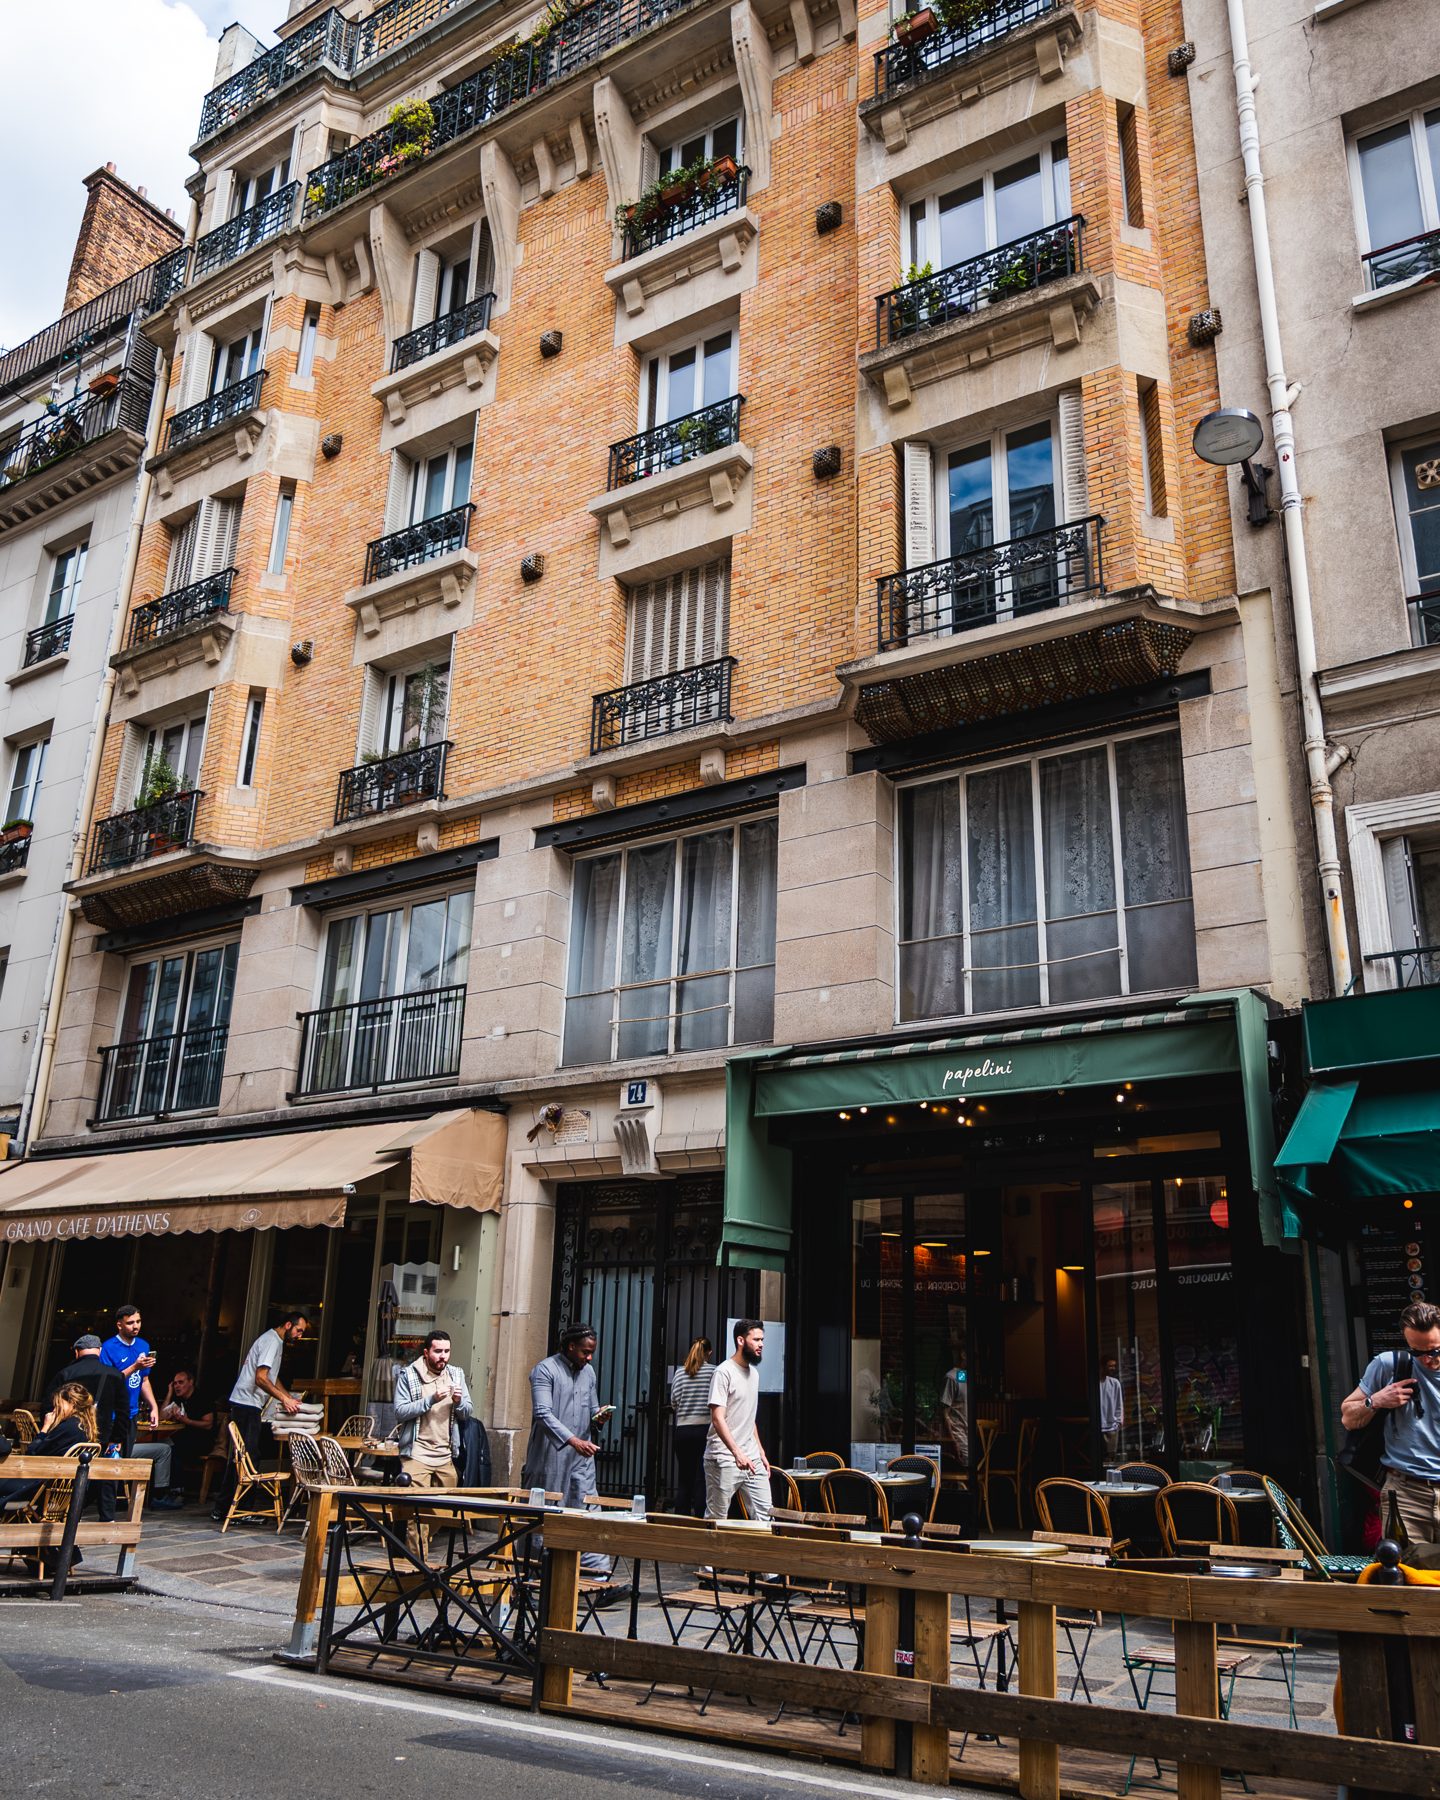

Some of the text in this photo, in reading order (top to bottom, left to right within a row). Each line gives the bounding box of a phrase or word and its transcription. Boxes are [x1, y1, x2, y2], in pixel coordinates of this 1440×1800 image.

[942, 1059, 1013, 1090] papelini
[629, 1084, 643, 1102] 74
[6, 1212, 171, 1239] GRAND CAFE D'ATHENES
